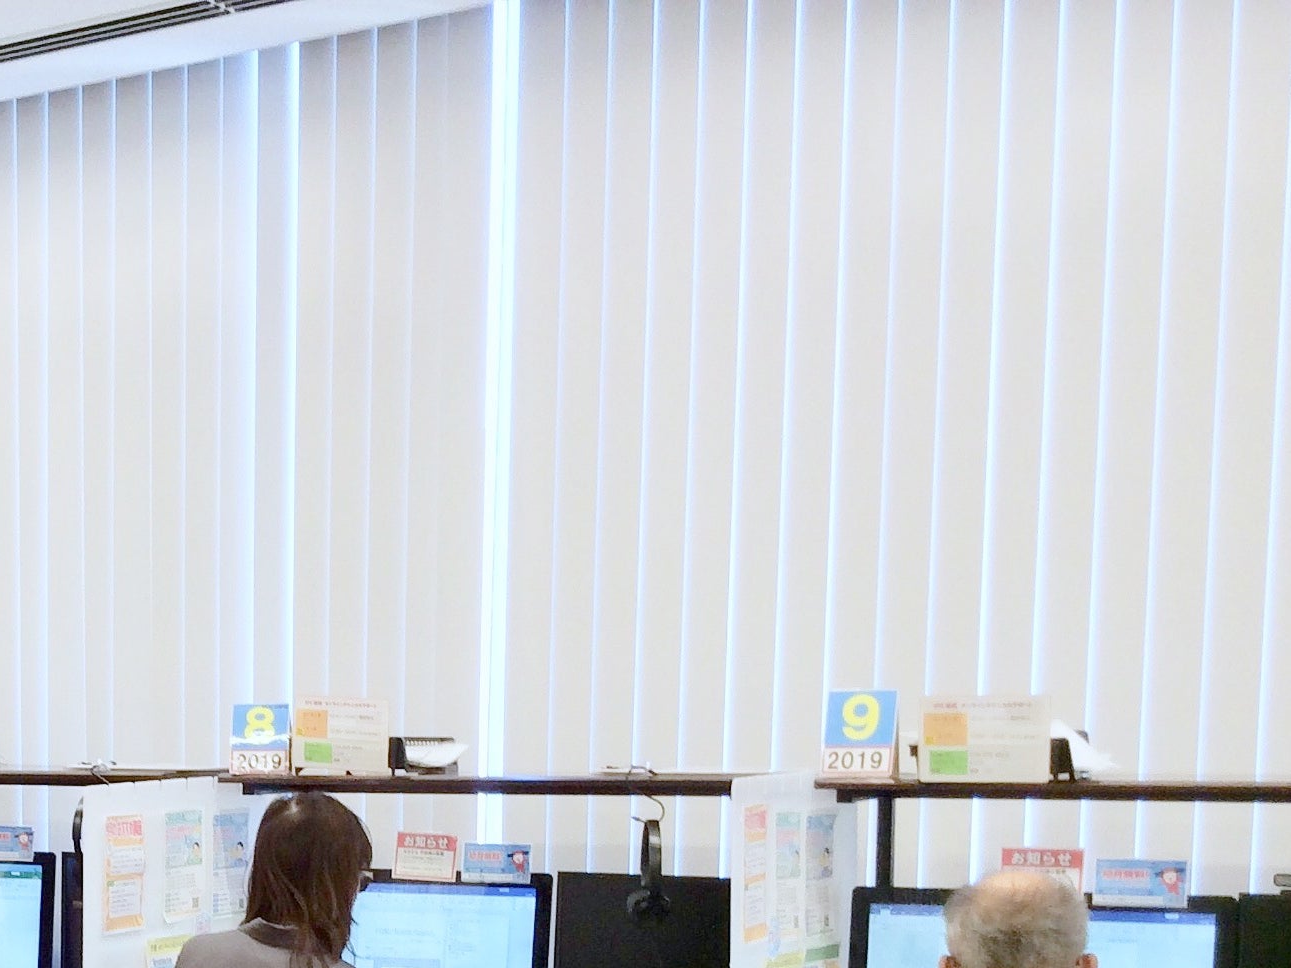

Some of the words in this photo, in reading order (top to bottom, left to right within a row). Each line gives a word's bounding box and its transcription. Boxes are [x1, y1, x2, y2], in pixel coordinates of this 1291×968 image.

[244, 706, 275, 739] 8
[842, 694, 880, 741] 9
[237, 754, 281, 769] 2019
[827, 751, 883, 769] 2019
[404, 836, 449, 849] お知らせ
[1011, 852, 1072, 866] お知らせ
